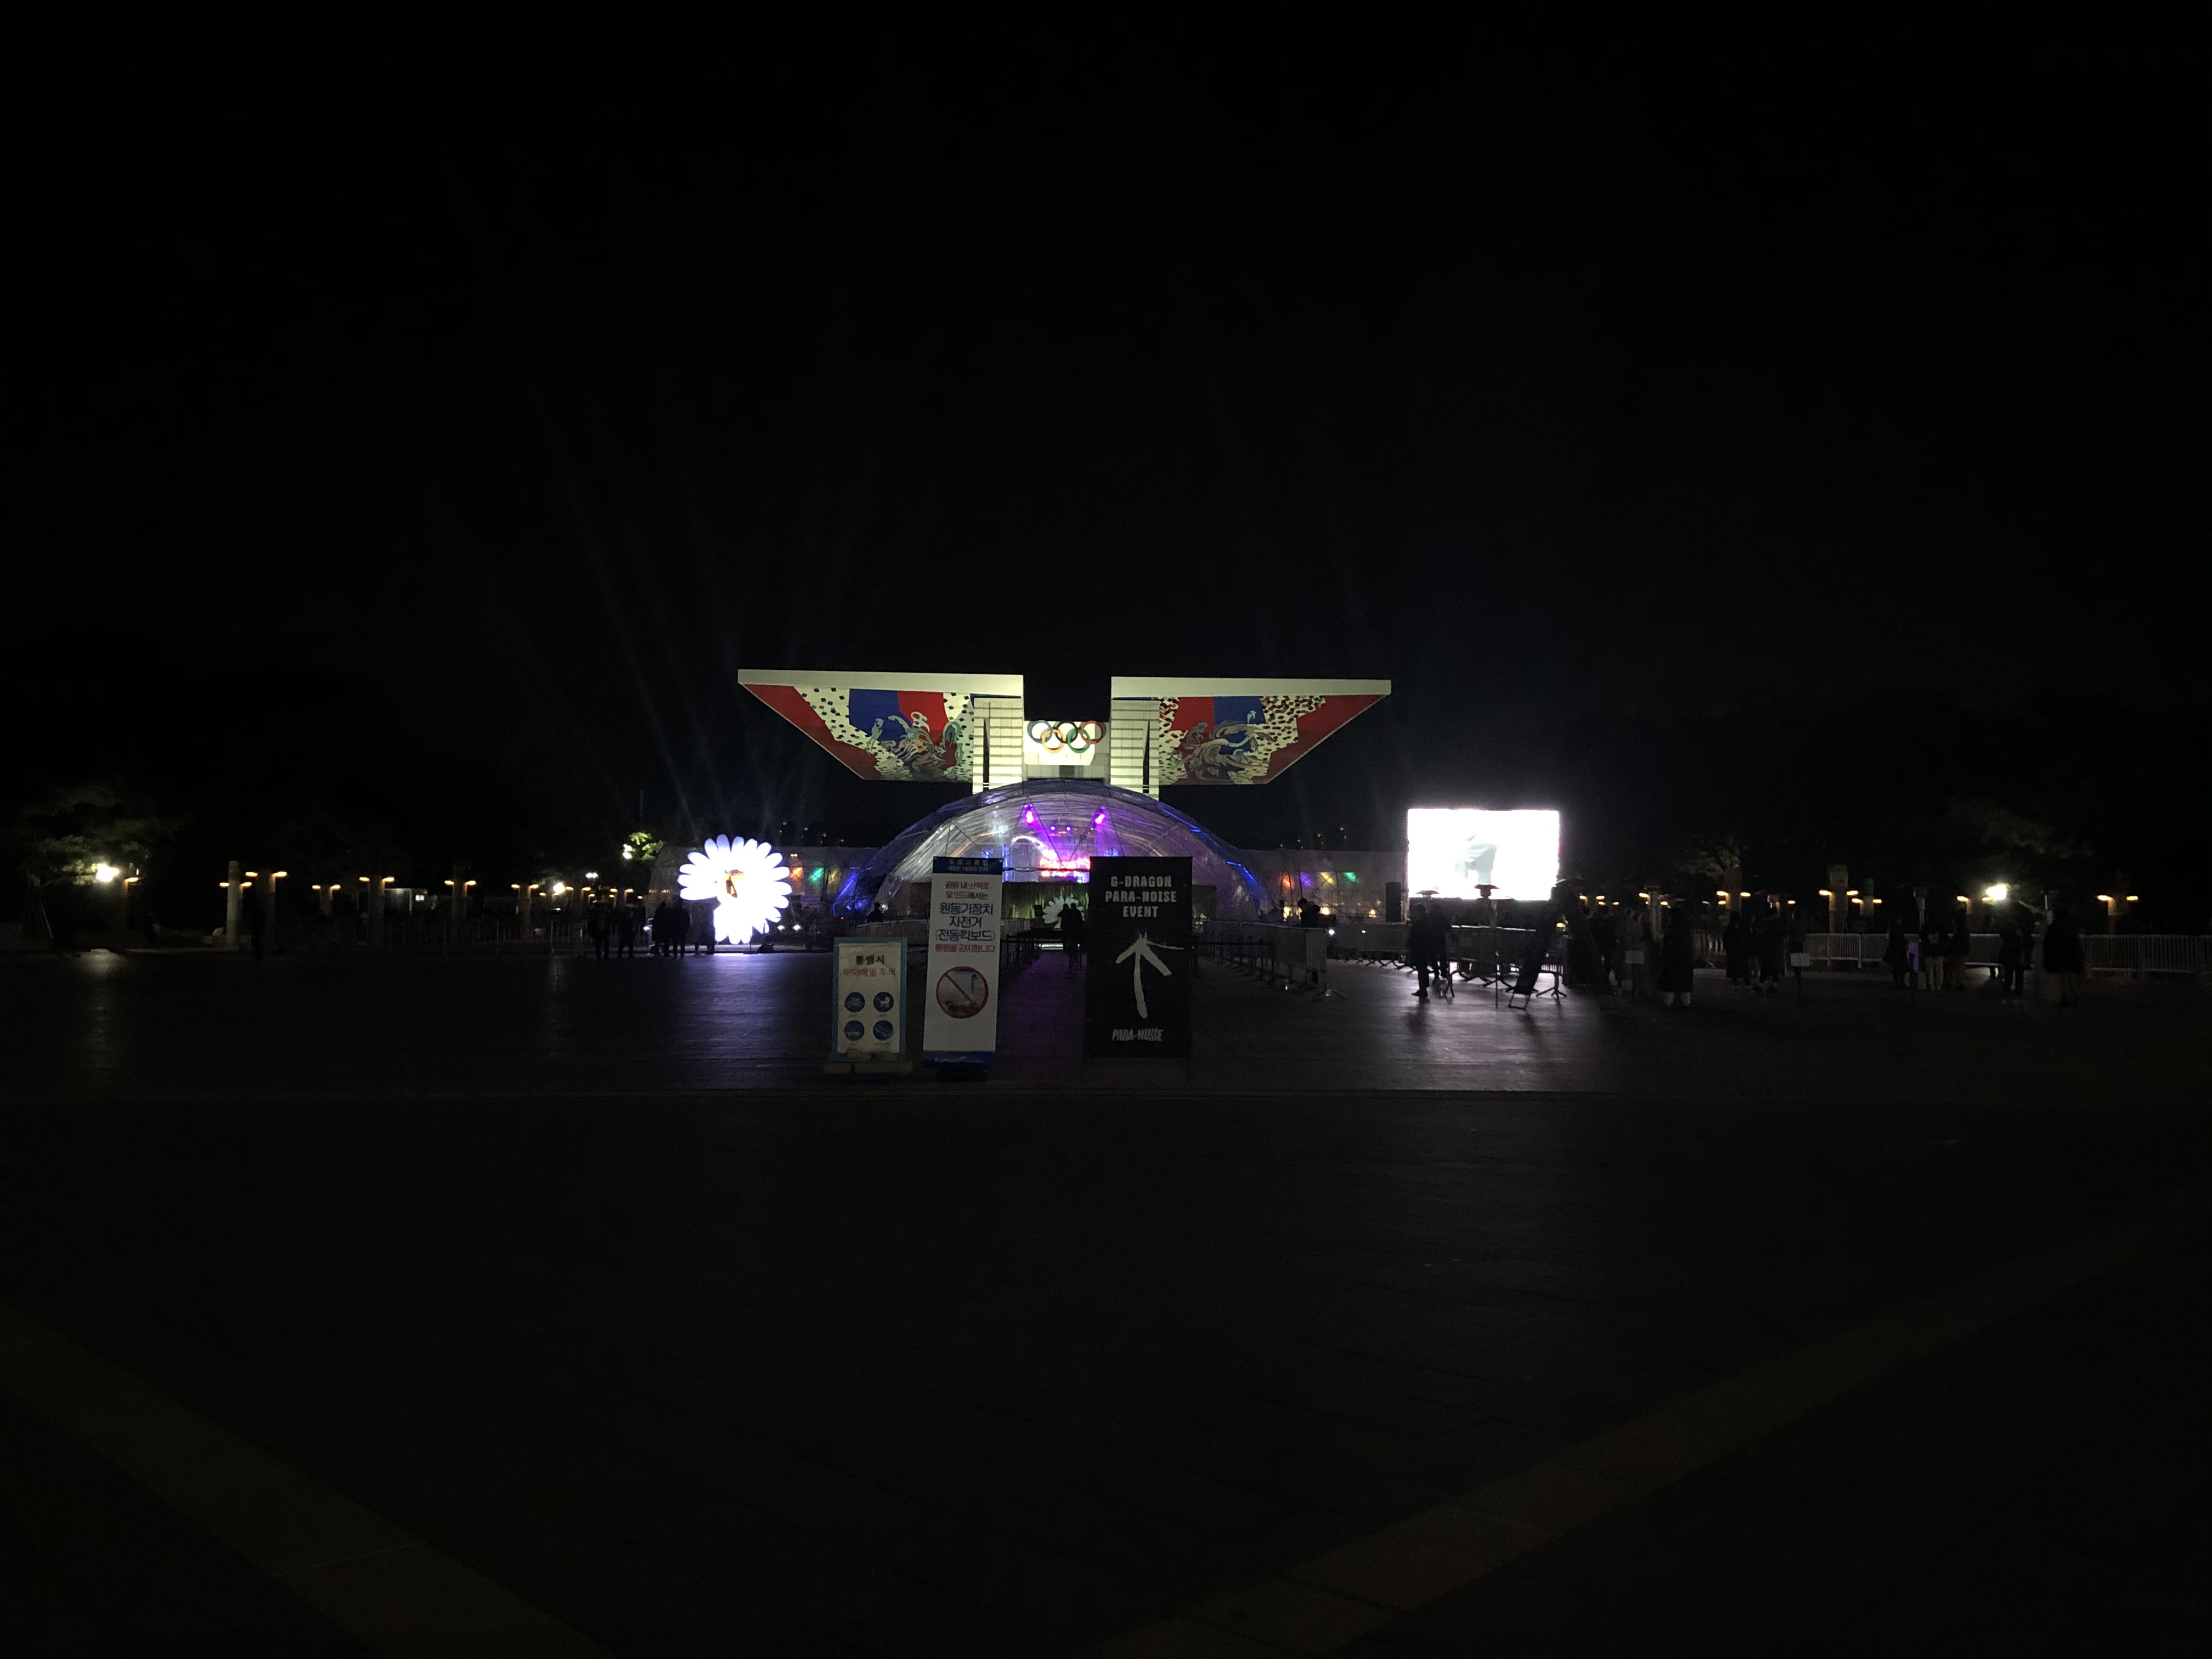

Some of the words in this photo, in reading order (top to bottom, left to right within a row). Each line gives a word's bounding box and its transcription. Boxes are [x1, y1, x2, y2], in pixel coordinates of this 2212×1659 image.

[1110, 875, 1172, 888] G-DRAGON
[1105, 890, 1177, 902] PARA-NOISE
[940, 902, 993, 915] 원동기장치
[1123, 905, 1159, 918] EVENT
[949, 916, 982, 928] 자전거
[935, 929, 995, 941] (전동킥보드)
